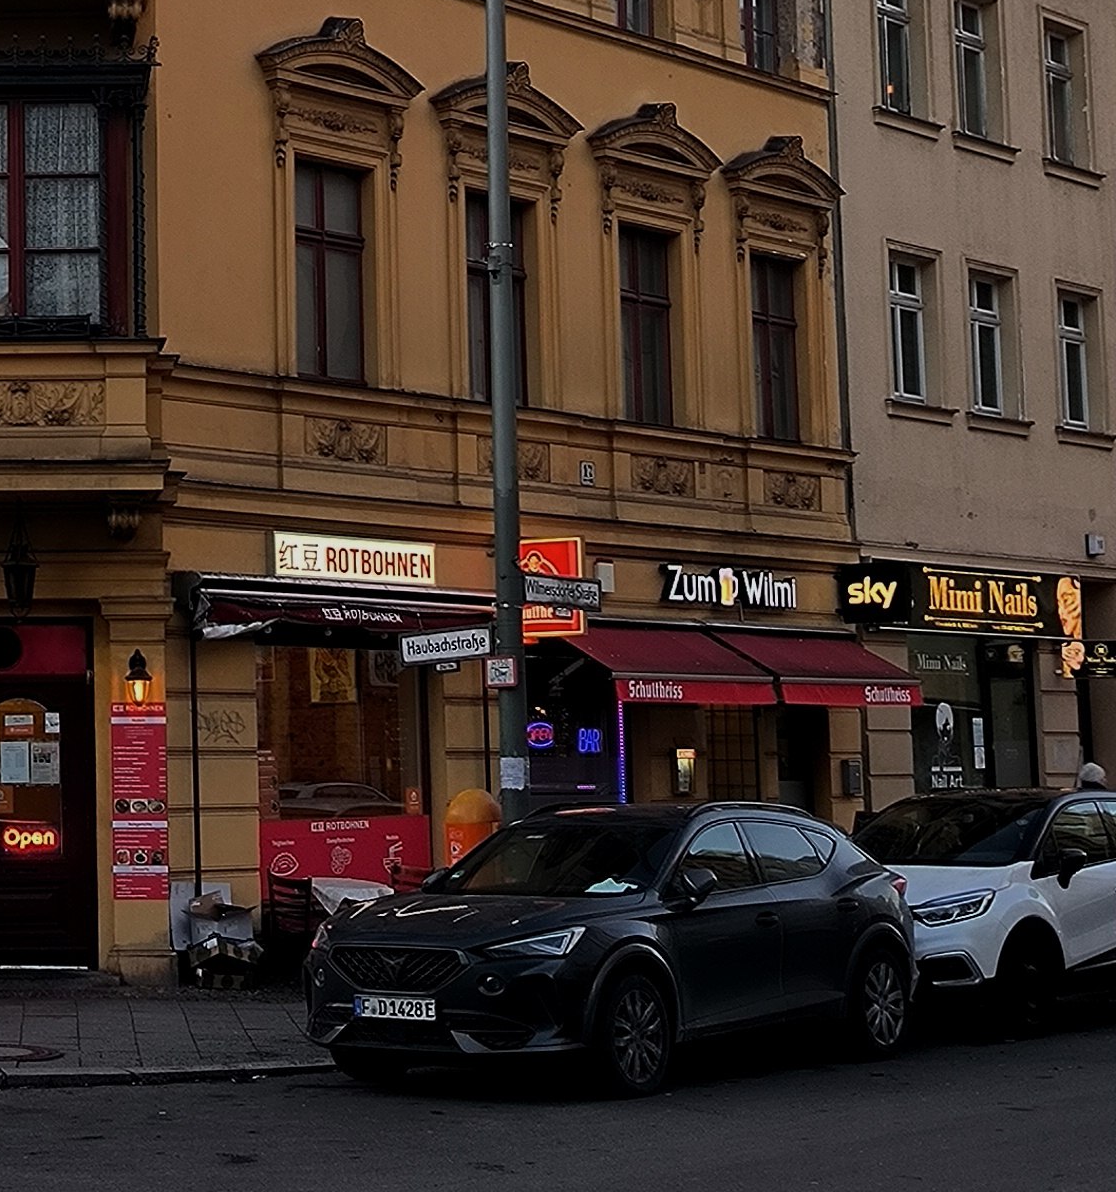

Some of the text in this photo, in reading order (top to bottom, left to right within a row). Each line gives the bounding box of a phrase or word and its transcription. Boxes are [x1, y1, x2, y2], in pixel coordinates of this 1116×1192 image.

[279, 540, 432, 579] 红豆 ROTBOHNEN
[667, 564, 797, 608] Zum Wilmi
[847, 575, 898, 609] sky
[927, 575, 1038, 617] Mimi Nails
[405, 633, 486, 656] Haubachstraße
[628, 680, 684, 700] Schultheiss
[864, 685, 912, 703] Schultheiss
[578, 728, 601, 753] BAR
[931, 774, 963, 788] Nail Art
[3, 827, 55, 849] Open
